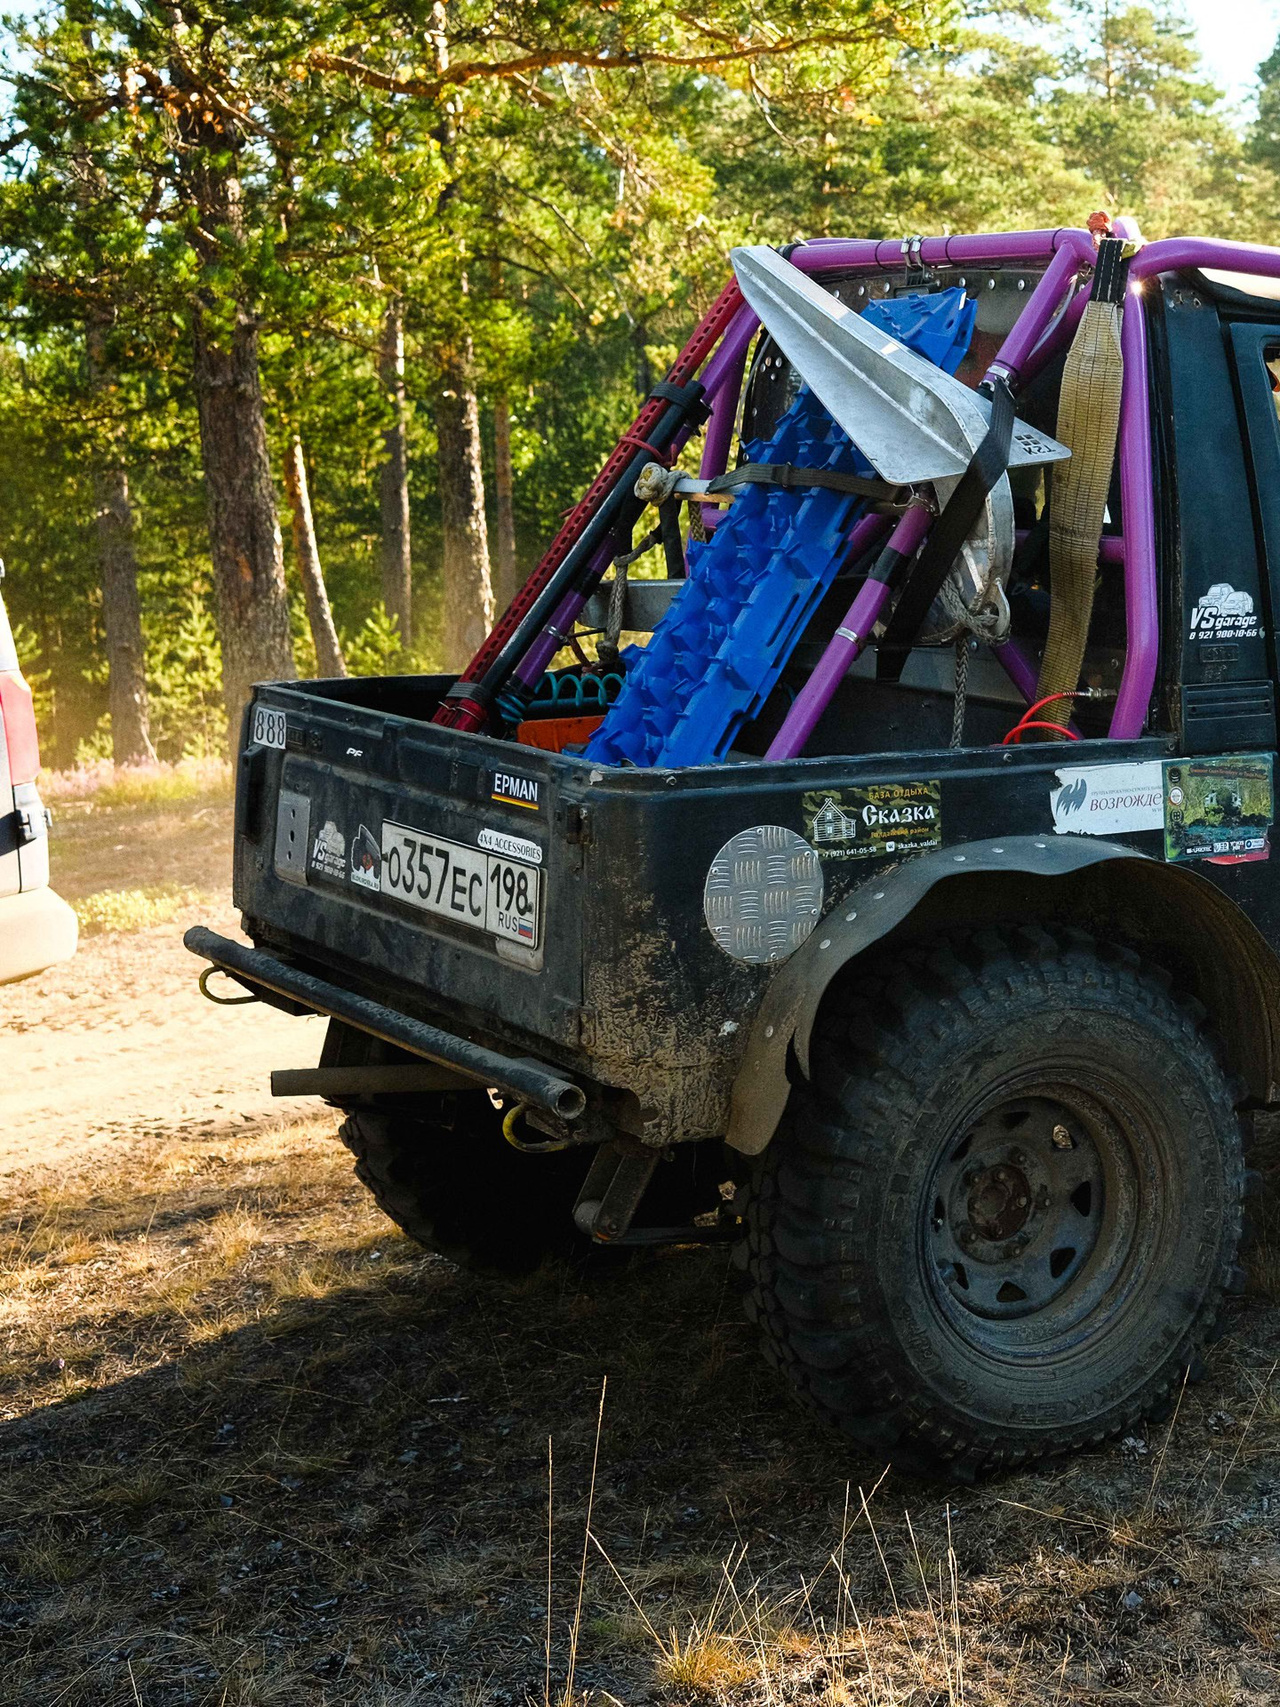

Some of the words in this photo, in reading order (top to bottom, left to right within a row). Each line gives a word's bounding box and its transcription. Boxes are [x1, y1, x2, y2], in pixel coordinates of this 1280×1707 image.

[1190, 607, 1218, 630] VS
[1214, 615, 1257, 630] garage
[1189, 632, 1197, 640] 8
[1198, 631, 1214, 640] 921
[256, 711, 285, 746] 888
[494, 773, 538, 802] EPMAN
[868, 791, 891, 800] БАЗА
[893, 787, 929, 798] ОТДЫХА
[862, 805, 936, 826] Сказка
[313, 838, 327, 861] VS
[479, 833, 492, 845] 4X4
[495, 837, 541, 861] ACCESSORIES
[490, 863, 529, 916] 198
[498, 911, 518, 932] RUS
